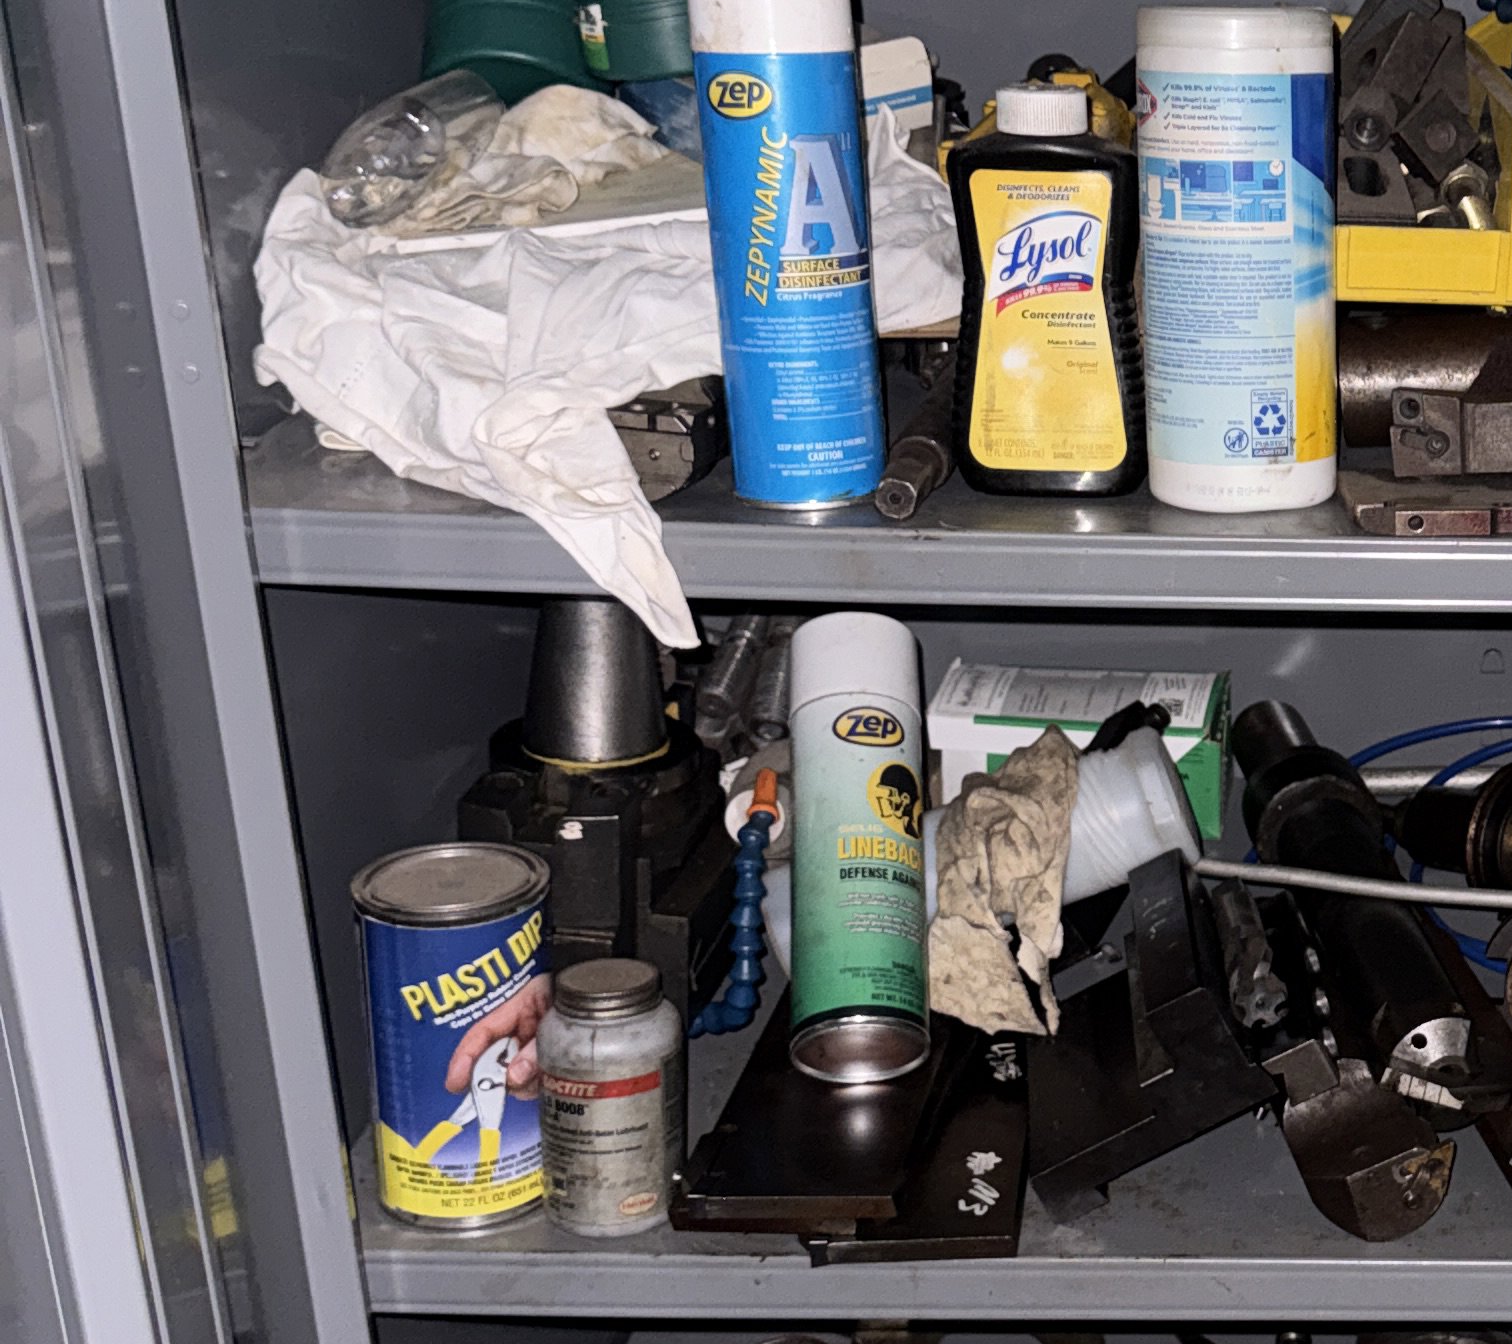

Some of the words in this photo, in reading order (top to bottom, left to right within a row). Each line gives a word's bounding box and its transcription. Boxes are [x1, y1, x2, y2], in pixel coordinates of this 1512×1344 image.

[779, 133, 866, 256] A
[1047, 184, 1081, 193] CLEANS
[1015, 193, 1070, 201] DEODORIZES
[745, 125, 788, 307] ZEPYNAMIC
[997, 220, 1092, 283] Lysol
[782, 258, 840, 273] SURFACE
[778, 270, 862, 289] DISINFECTANT
[776, 291, 802, 302] Citrus
[803, 290, 843, 302] Fragrance
[1021, 309, 1096, 321] Concentrate
[1047, 320, 1096, 329] Disinfectant
[1066, 360, 1099, 369] Original
[808, 450, 844, 462] CAUTION
[839, 867, 889, 880] DEFENSE
[400, 947, 512, 1021] PLASTI
[506, 910, 543, 967] DIP
[441, 1198, 459, 1207] NET
[463, 1197, 475, 1207] 22
[478, 1196, 489, 1204] FL
[492, 1191, 506, 1202] OZ
